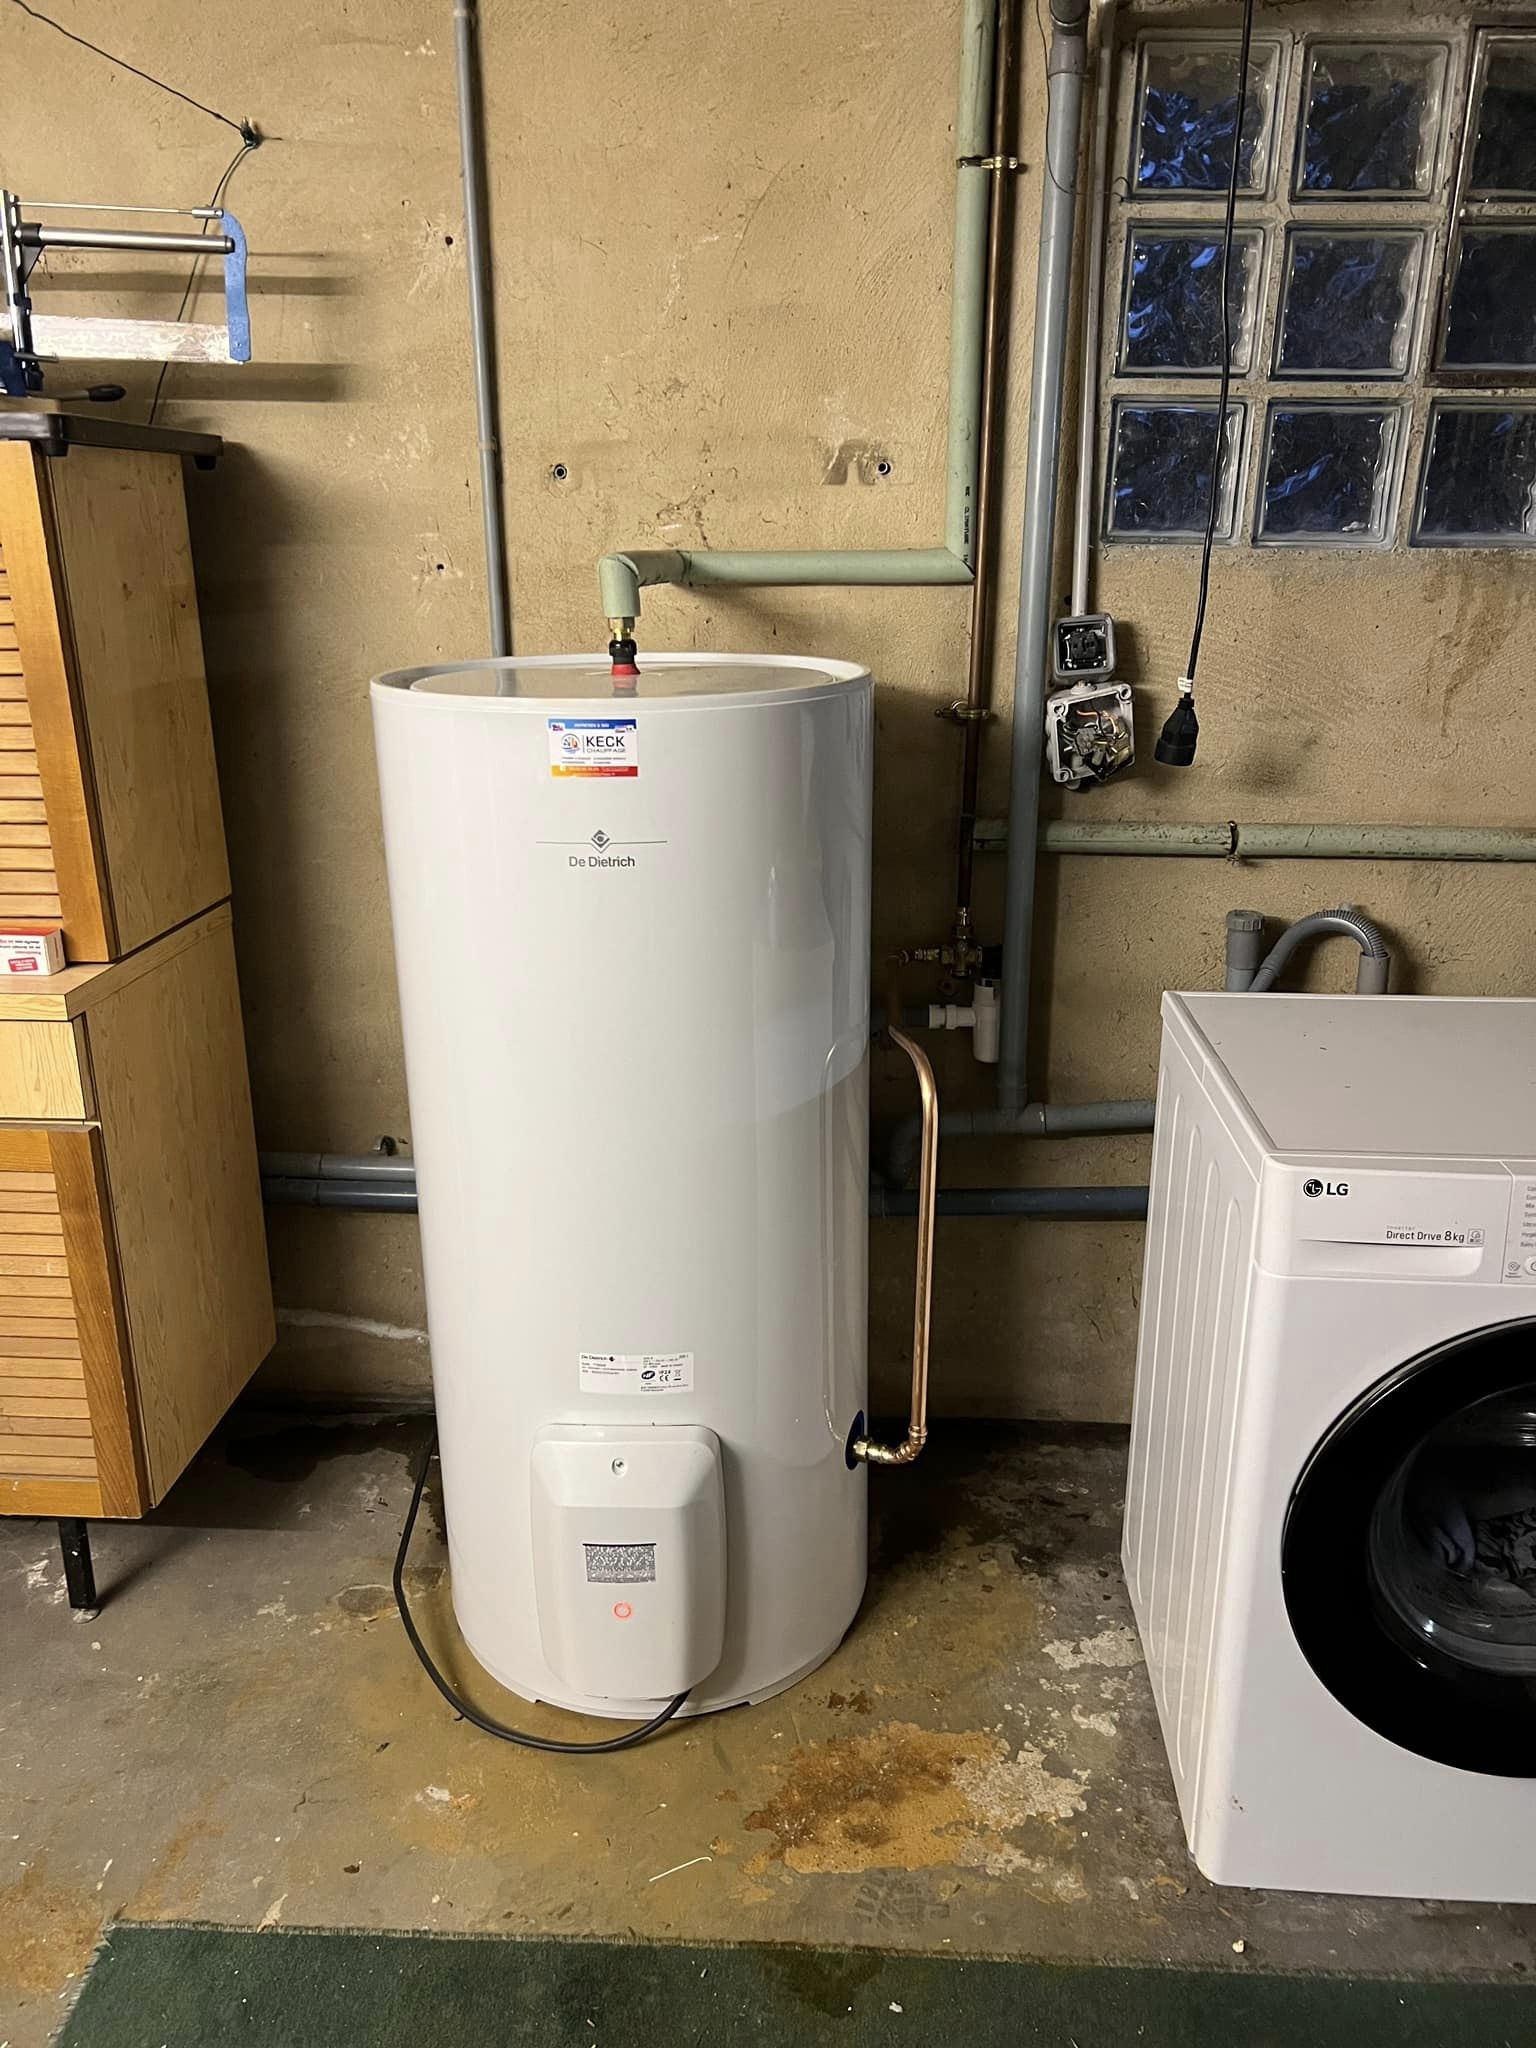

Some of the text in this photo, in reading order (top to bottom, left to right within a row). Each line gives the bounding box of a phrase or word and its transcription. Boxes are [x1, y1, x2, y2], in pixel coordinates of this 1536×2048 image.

[586, 735, 625, 748] KECK
[568, 855, 636, 868] De Dietrich
[1326, 1182, 1349, 1197] LG
[1386, 1230, 1415, 1240] Direct
[1416, 1231, 1442, 1241] Drive
